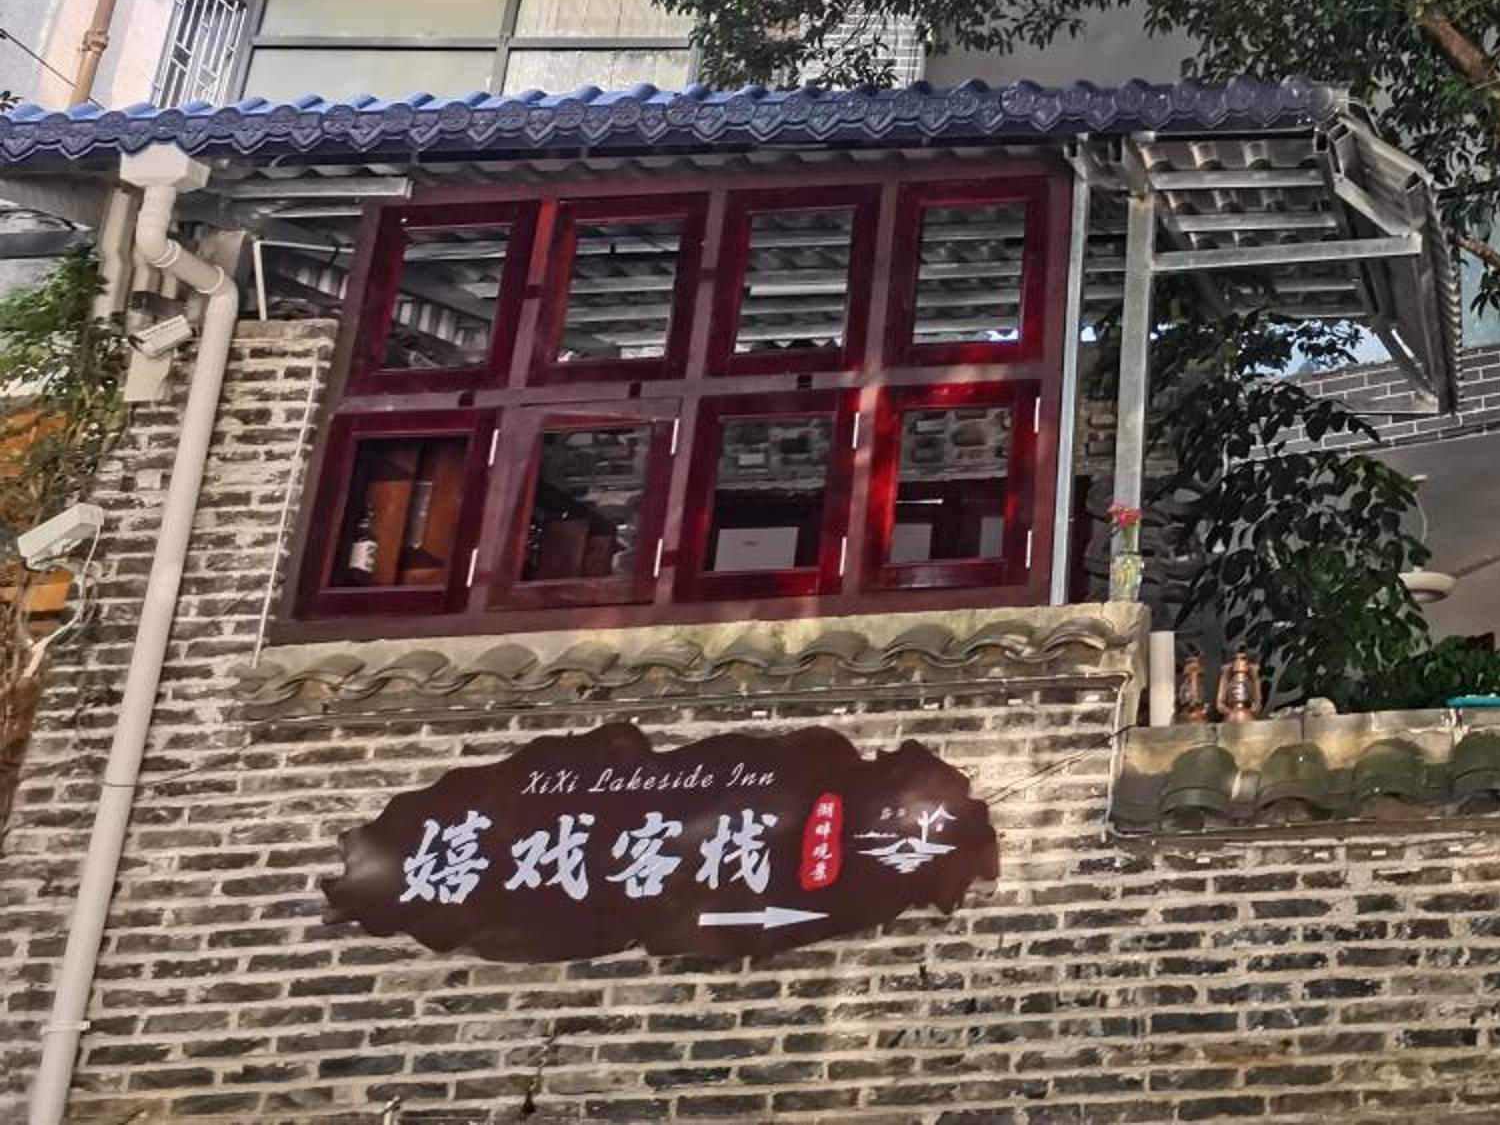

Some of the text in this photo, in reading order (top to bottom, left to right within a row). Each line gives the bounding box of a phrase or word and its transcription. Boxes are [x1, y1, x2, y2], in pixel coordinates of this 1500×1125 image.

[521, 762, 775, 794] XiXi Lakeside Inn
[399, 809, 778, 904] 嬉戏客栈
